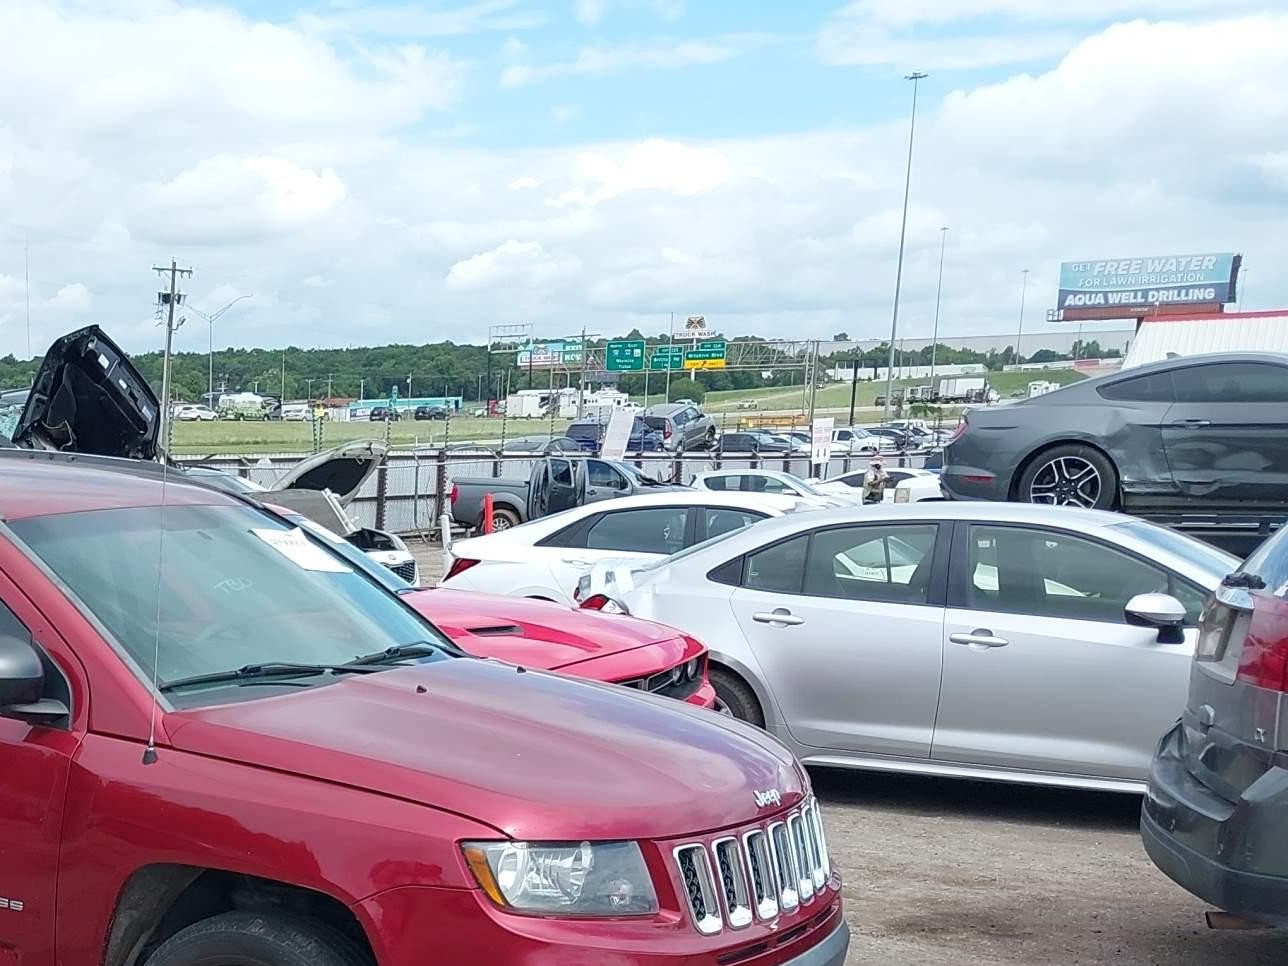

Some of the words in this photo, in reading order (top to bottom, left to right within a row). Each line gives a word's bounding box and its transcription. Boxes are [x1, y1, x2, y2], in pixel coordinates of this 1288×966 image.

[1072, 263, 1091, 272] GET
[1092, 259, 1143, 276] FREE
[1145, 255, 1217, 273] WATER
[1079, 278, 1101, 288] FOR
[1102, 275, 1138, 286] LAWN
[1138, 272, 1204, 284] IRRIGATION
[1064, 295, 1106, 306] AQUA
[1107, 291, 1145, 304] WELL
[1147, 287, 1216, 301] DRILLING
[752, 788, 781, 807] Jeep
